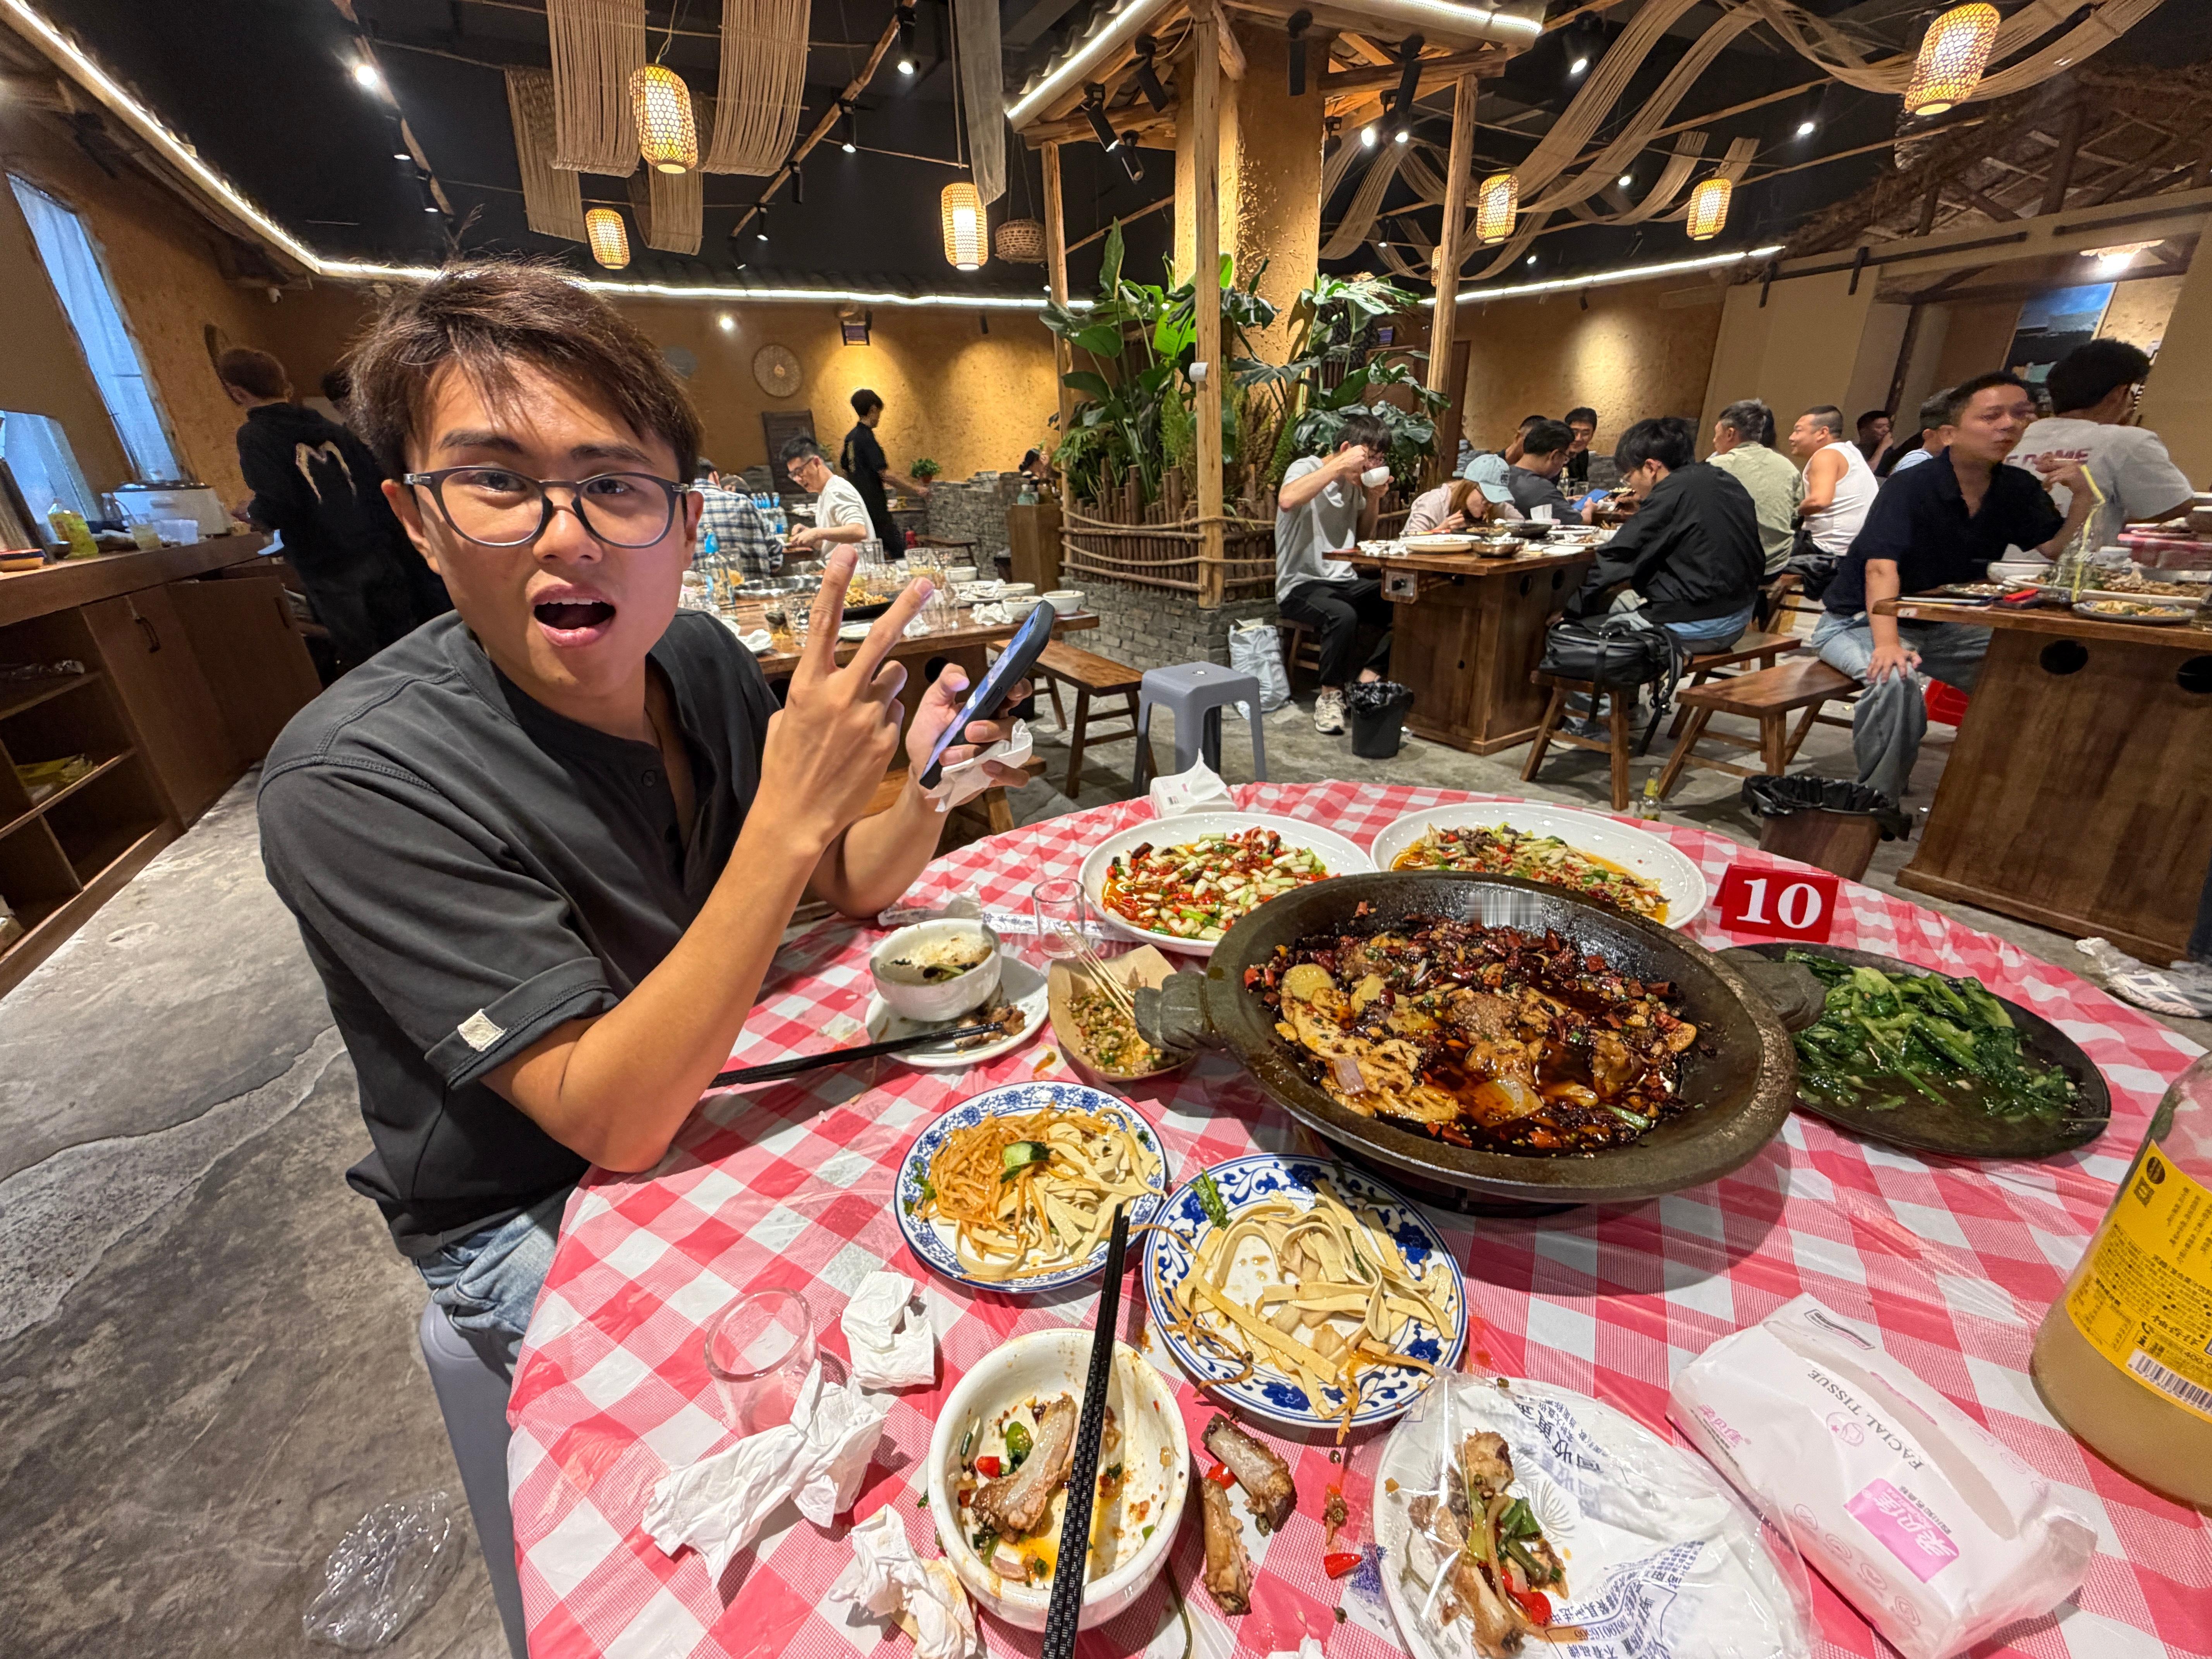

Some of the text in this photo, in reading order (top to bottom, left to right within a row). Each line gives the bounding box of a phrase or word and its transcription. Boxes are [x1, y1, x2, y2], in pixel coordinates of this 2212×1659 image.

[1736, 878, 1822, 929] 10
[1539, 1402, 1574, 1443] 实时大盘价
[1698, 1404, 1743, 1445] 柔贝佳
[1807, 1370, 1925, 1470] FACIAL TISSUE
[1873, 1490, 1959, 1558] 柔贝佳
[1898, 1485, 1953, 1535] 四川知名商标
